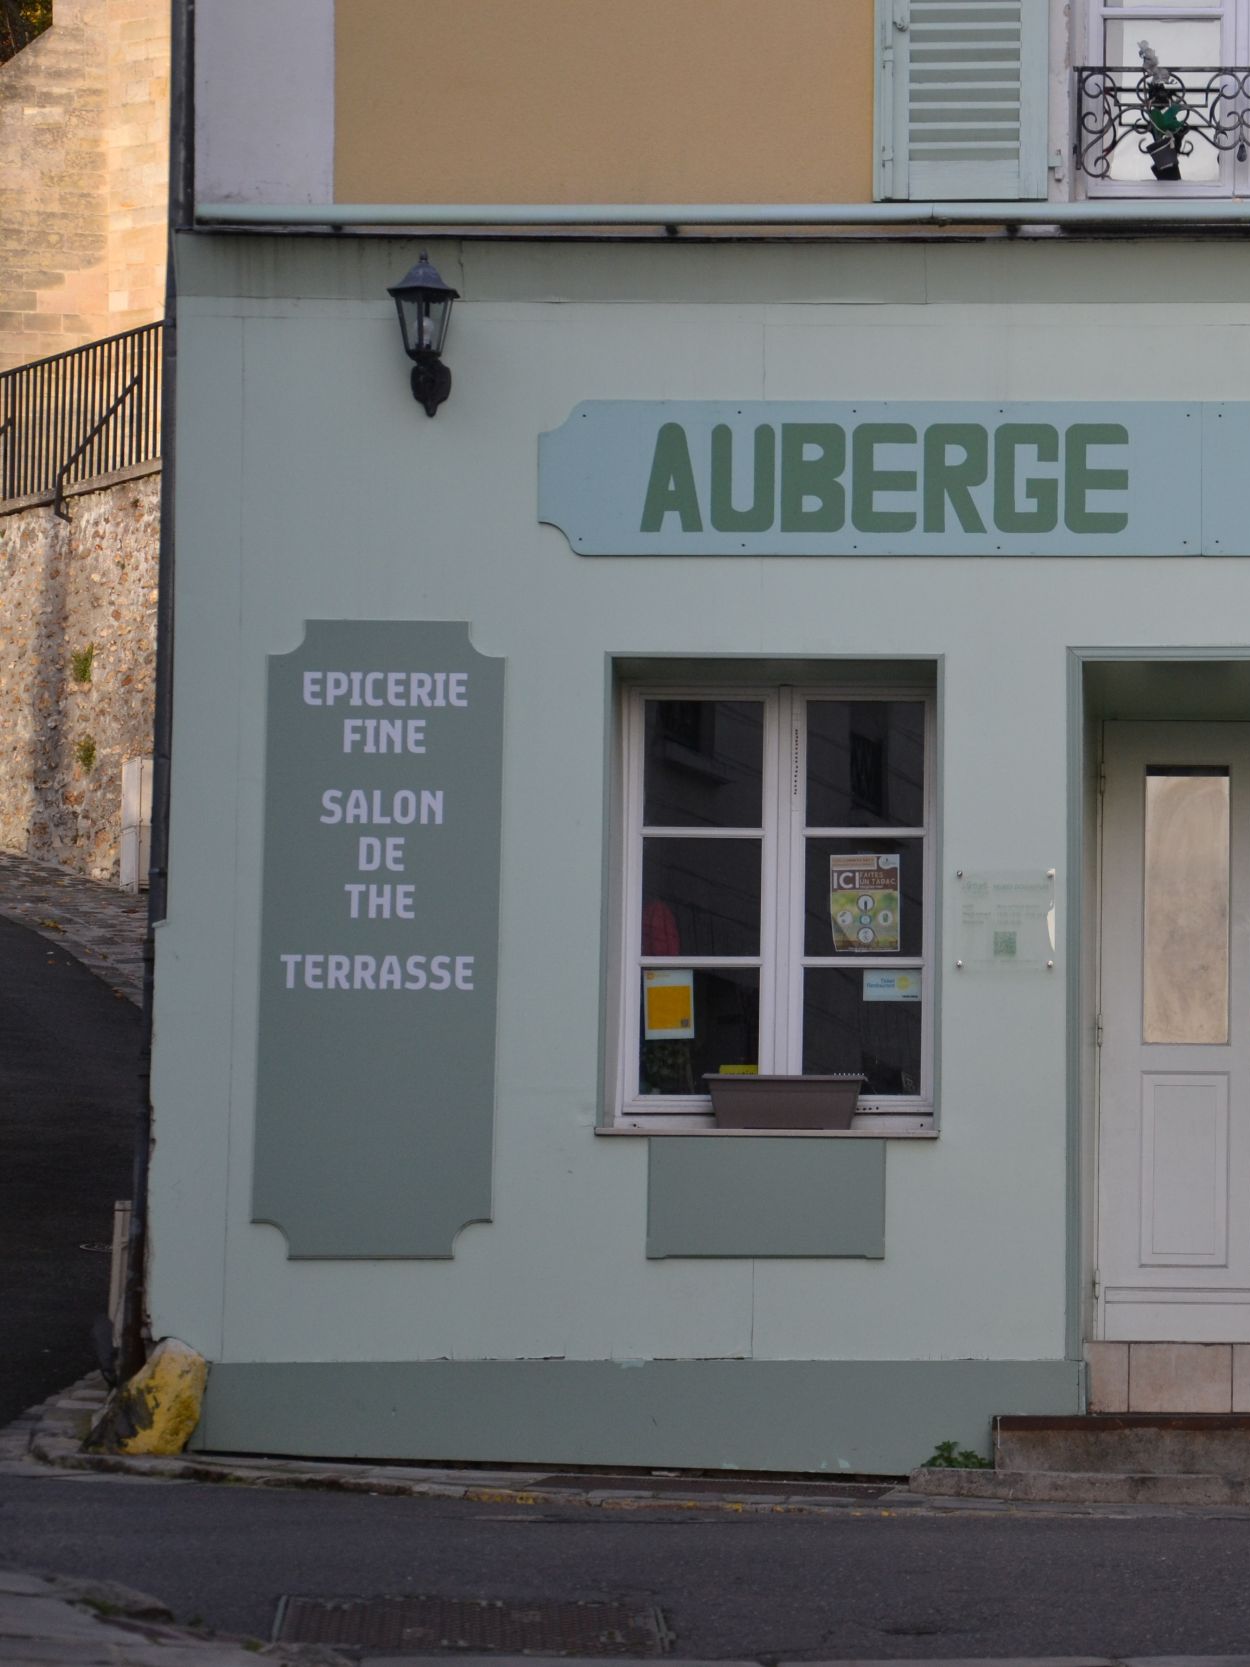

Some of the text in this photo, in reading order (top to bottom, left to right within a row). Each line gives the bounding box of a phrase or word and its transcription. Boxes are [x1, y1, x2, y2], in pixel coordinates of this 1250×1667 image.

[640, 422, 1129, 534] AUBERGE
[303, 671, 469, 707] EPICERIE
[343, 719, 427, 754] FINE
[319, 789, 444, 825] SALON
[358, 837, 405, 872] DE
[833, 871, 860, 889] ICI
[344, 884, 416, 919] THE
[280, 954, 475, 991] TERRASSE
